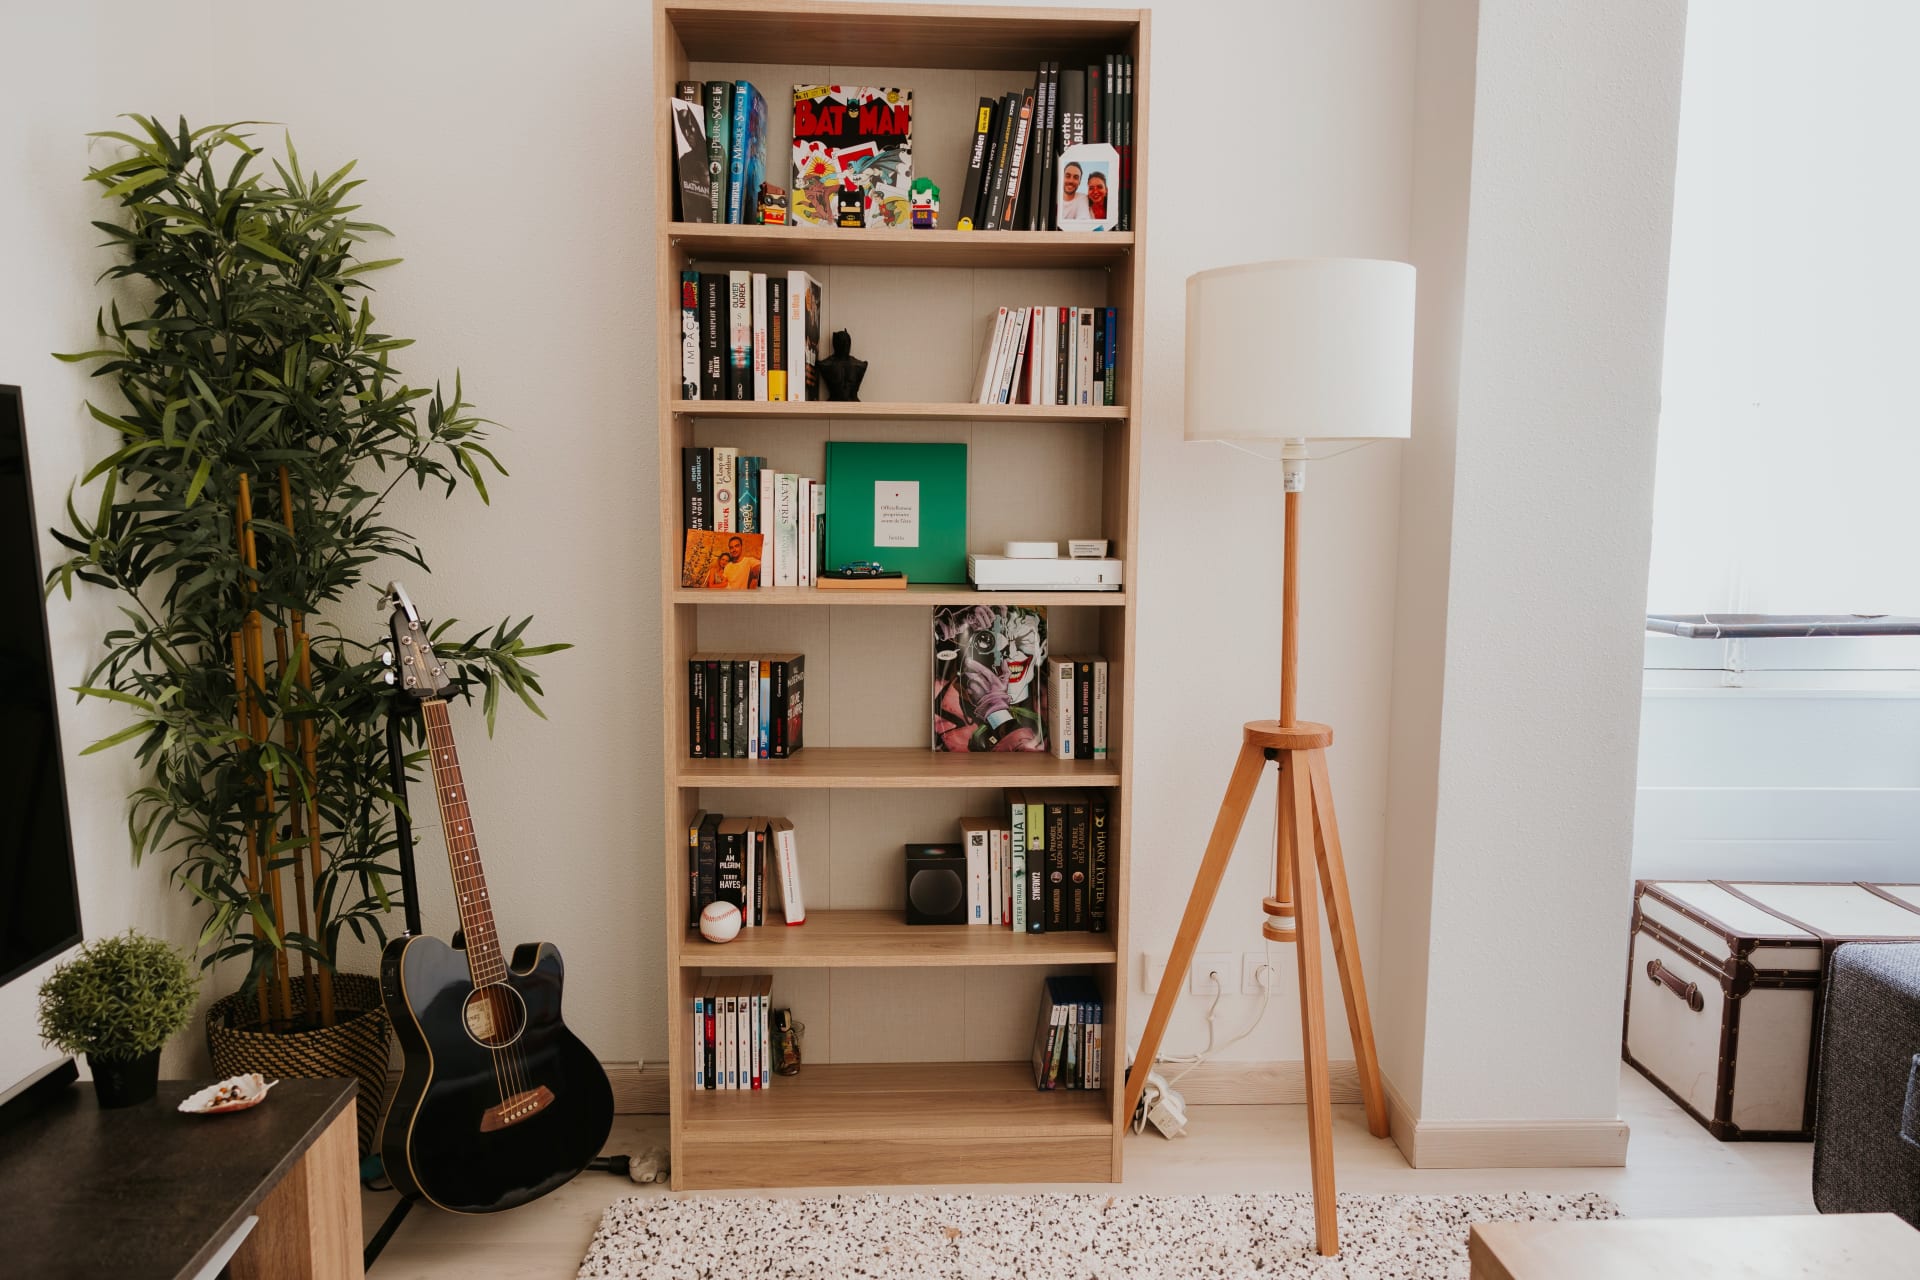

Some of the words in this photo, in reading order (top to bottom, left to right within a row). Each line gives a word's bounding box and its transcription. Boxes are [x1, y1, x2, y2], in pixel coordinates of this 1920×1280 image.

[1037, 82, 1046, 106] REBIRTH
[1047, 82, 1056, 106] REBIRTH
[711, 96, 722, 120] SAGE
[1036, 106, 1045, 128] BATMAN
[1046, 106, 1055, 128] BATMAN
[711, 126, 722, 149] PEUR
[1015, 120, 1028, 144] MAISON
[971, 134, 985, 168] L'italien
[1010, 167, 1018, 177] SA
[683, 180, 710, 194] BATMAN
[1006, 178, 1017, 196] FAIRE
[738, 282, 746, 308] NOREK
[709, 310, 717, 339] COMPLOT
[686, 314, 695, 364] IMPACT
[710, 340, 717, 348] LE
[712, 356, 720, 378] BERRY
[722, 454, 732, 483] Cordeliers
[780, 477, 789, 524] ELANTRIS
[1014, 822, 1024, 860] JULIA
[1096, 831, 1107, 863] HARRY
[720, 862, 740, 870] PILGRIM
[726, 854, 734, 862] AM
[1072, 850, 1078, 860] LA
[720, 880, 740, 888] HAYES
[1032, 872, 1041, 900] SYMFONY2
[1096, 867, 1106, 904] POTTER
